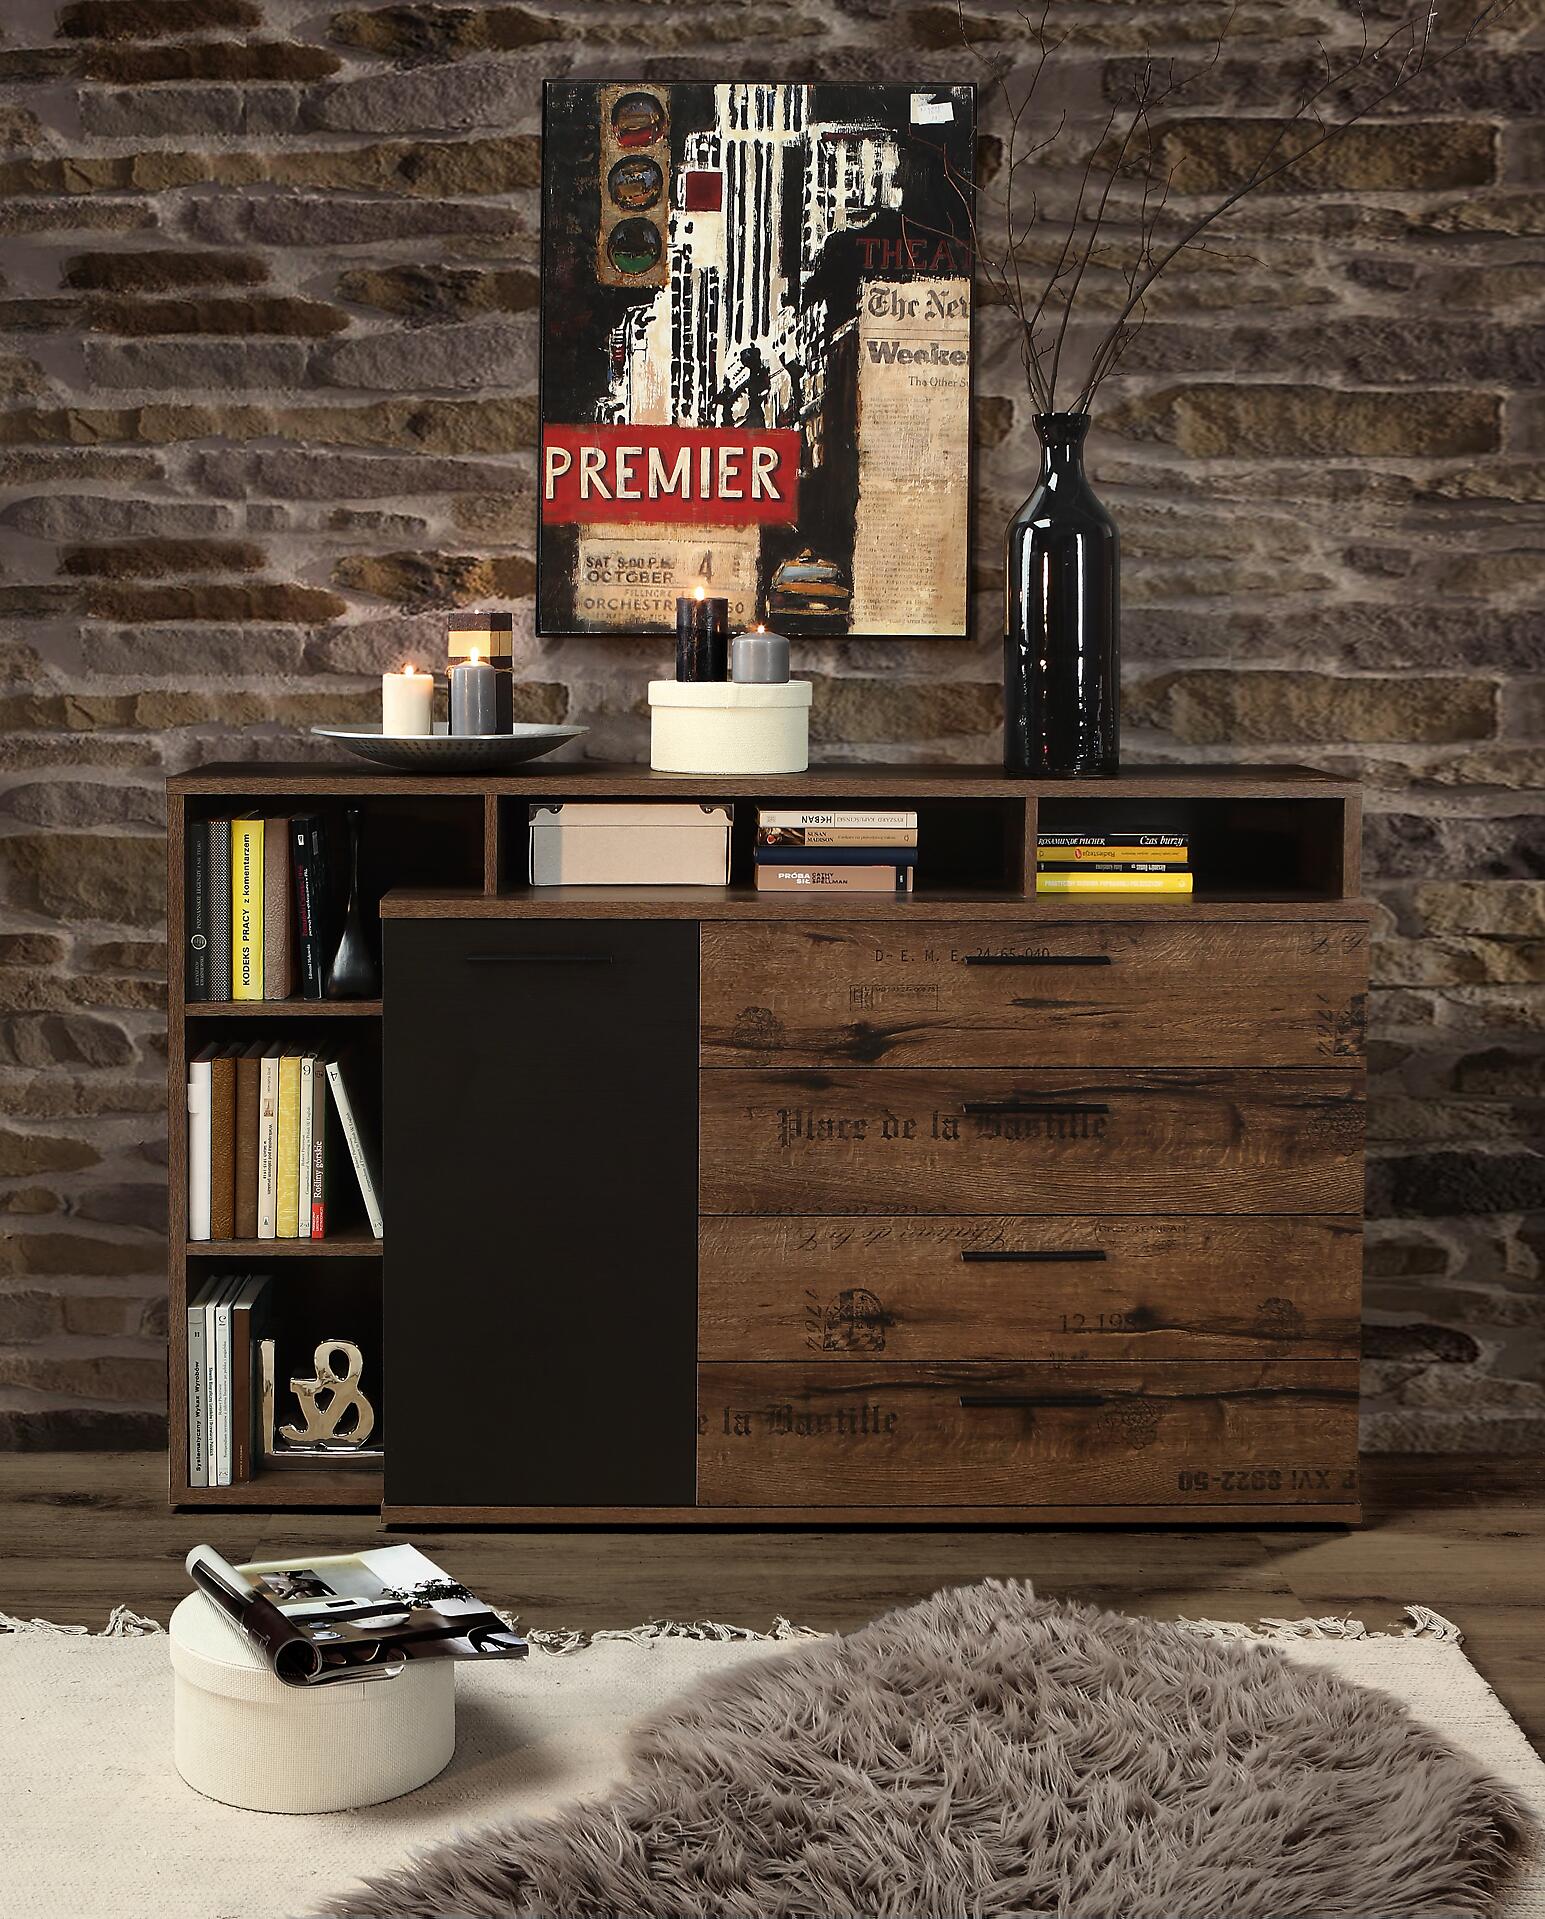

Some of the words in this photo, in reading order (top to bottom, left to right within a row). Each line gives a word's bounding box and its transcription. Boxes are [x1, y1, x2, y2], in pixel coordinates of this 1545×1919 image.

[867, 286, 920, 322] The
[545, 446, 781, 500] PREMIER
[586, 570, 674, 584] OCTOBER
[583, 598, 678, 611] ORCHESTR
[1139, 835, 1158, 845] Czas
[1160, 835, 1183, 847] burzy
[242, 834, 250, 896] komentarzem
[242, 909, 250, 942] PRACY
[242, 947, 250, 986] KODEKS
[880, 1109, 917, 1141] de
[930, 1111, 960, 1141] la
[313, 1140, 323, 1168] górskie
[313, 1170, 323, 1198] Rośliny
[722, 1405, 753, 1437] la
